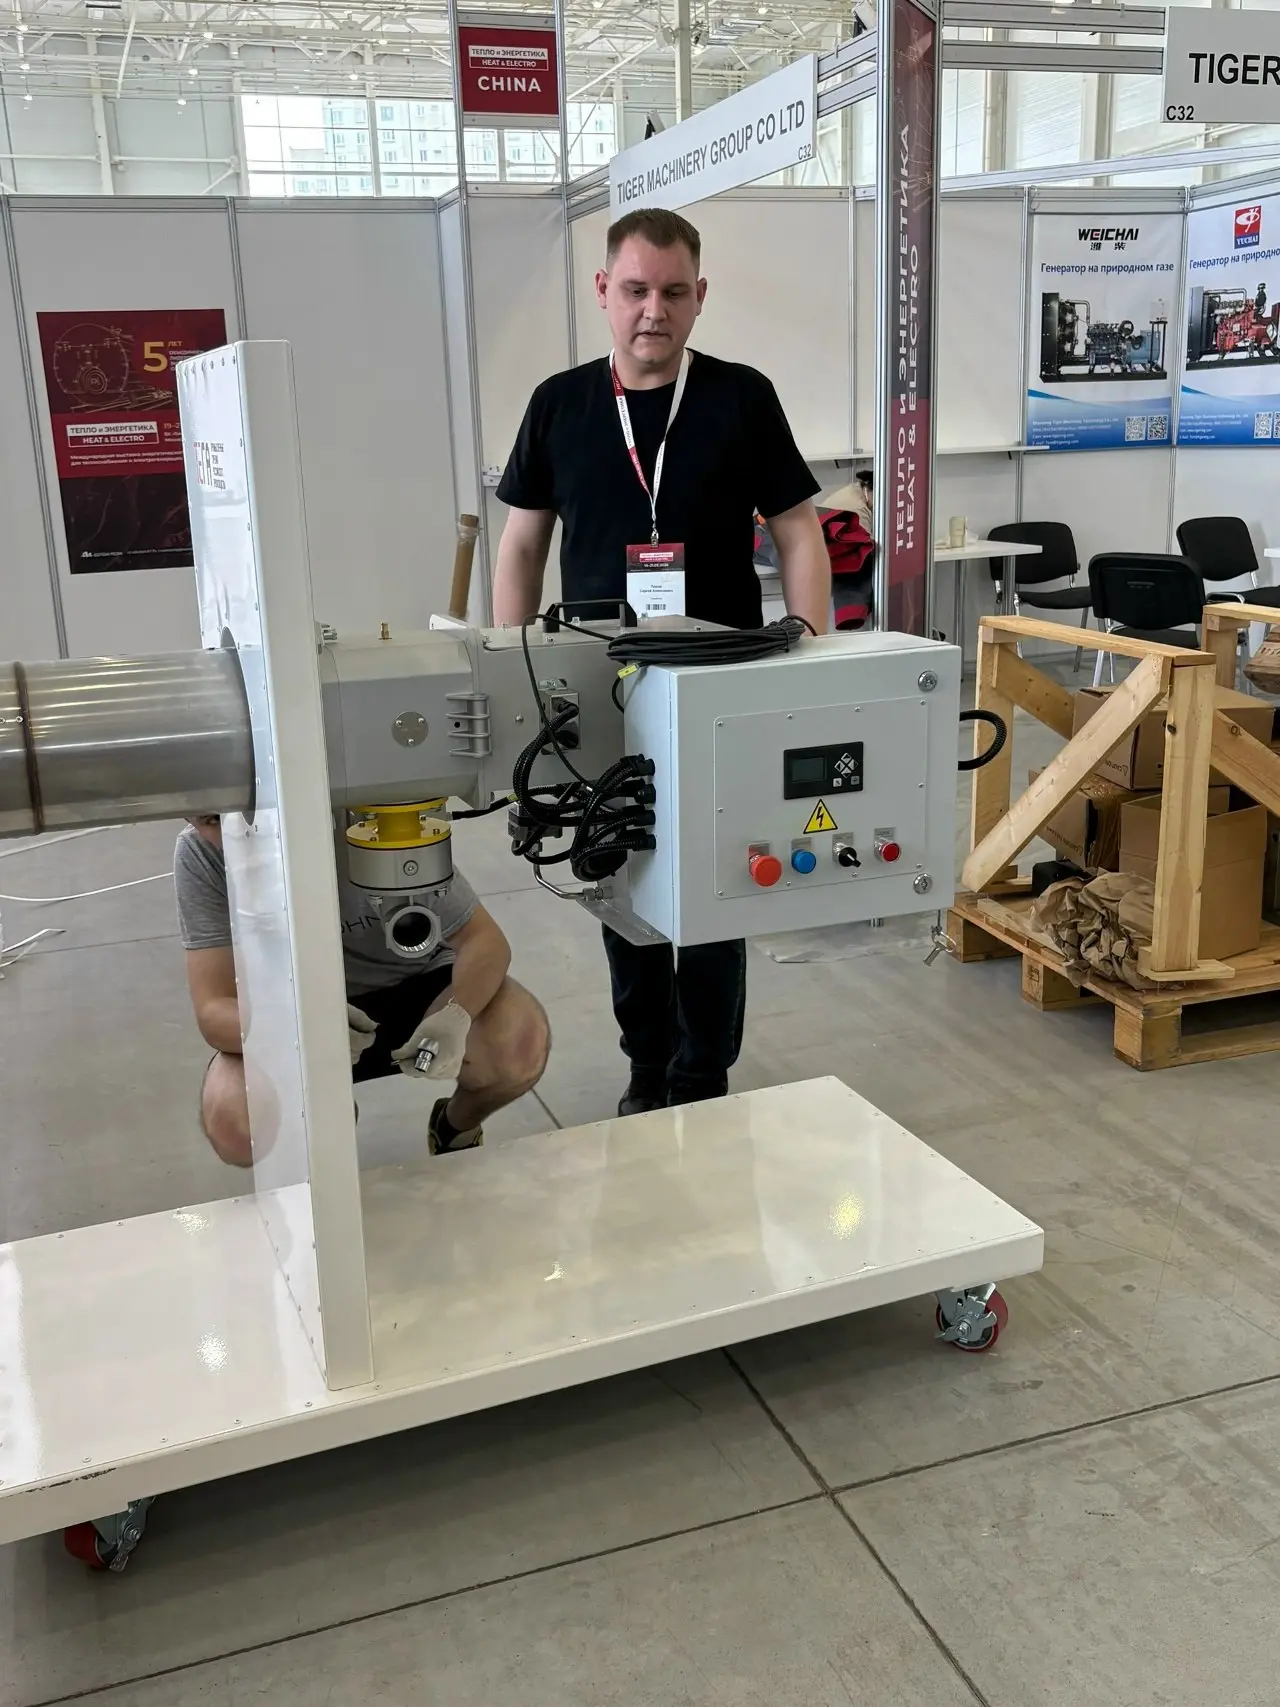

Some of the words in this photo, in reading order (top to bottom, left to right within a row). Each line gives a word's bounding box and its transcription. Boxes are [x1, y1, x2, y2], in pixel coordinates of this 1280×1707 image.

[1189, 52, 1280, 85] TIGER
[478, 76, 541, 92] CHINA
[1166, 105, 1194, 120] C32
[617, 174, 645, 204] TIGER
[647, 144, 707, 192] MACHINERY
[710, 124, 753, 165] GROUP
[757, 113, 776, 144] CO
[780, 100, 804, 135] LTD
[798, 144, 811, 160] C32
[1078, 228, 1139, 240] WEICHAI
[899, 124, 908, 381] ЭНЕРГЕТИКА
[1190, 257, 1229, 270] Генератор
[1231, 255, 1239, 263] на
[1041, 263, 1086, 275] Генератор
[1101, 264, 1153, 275] природном
[909, 245, 918, 411] ELECTRO
[143, 341, 168, 372] 5
[909, 424, 915, 446] &
[896, 427, 905, 555] ТЕПЛО
[907, 457, 915, 549] HEAT
